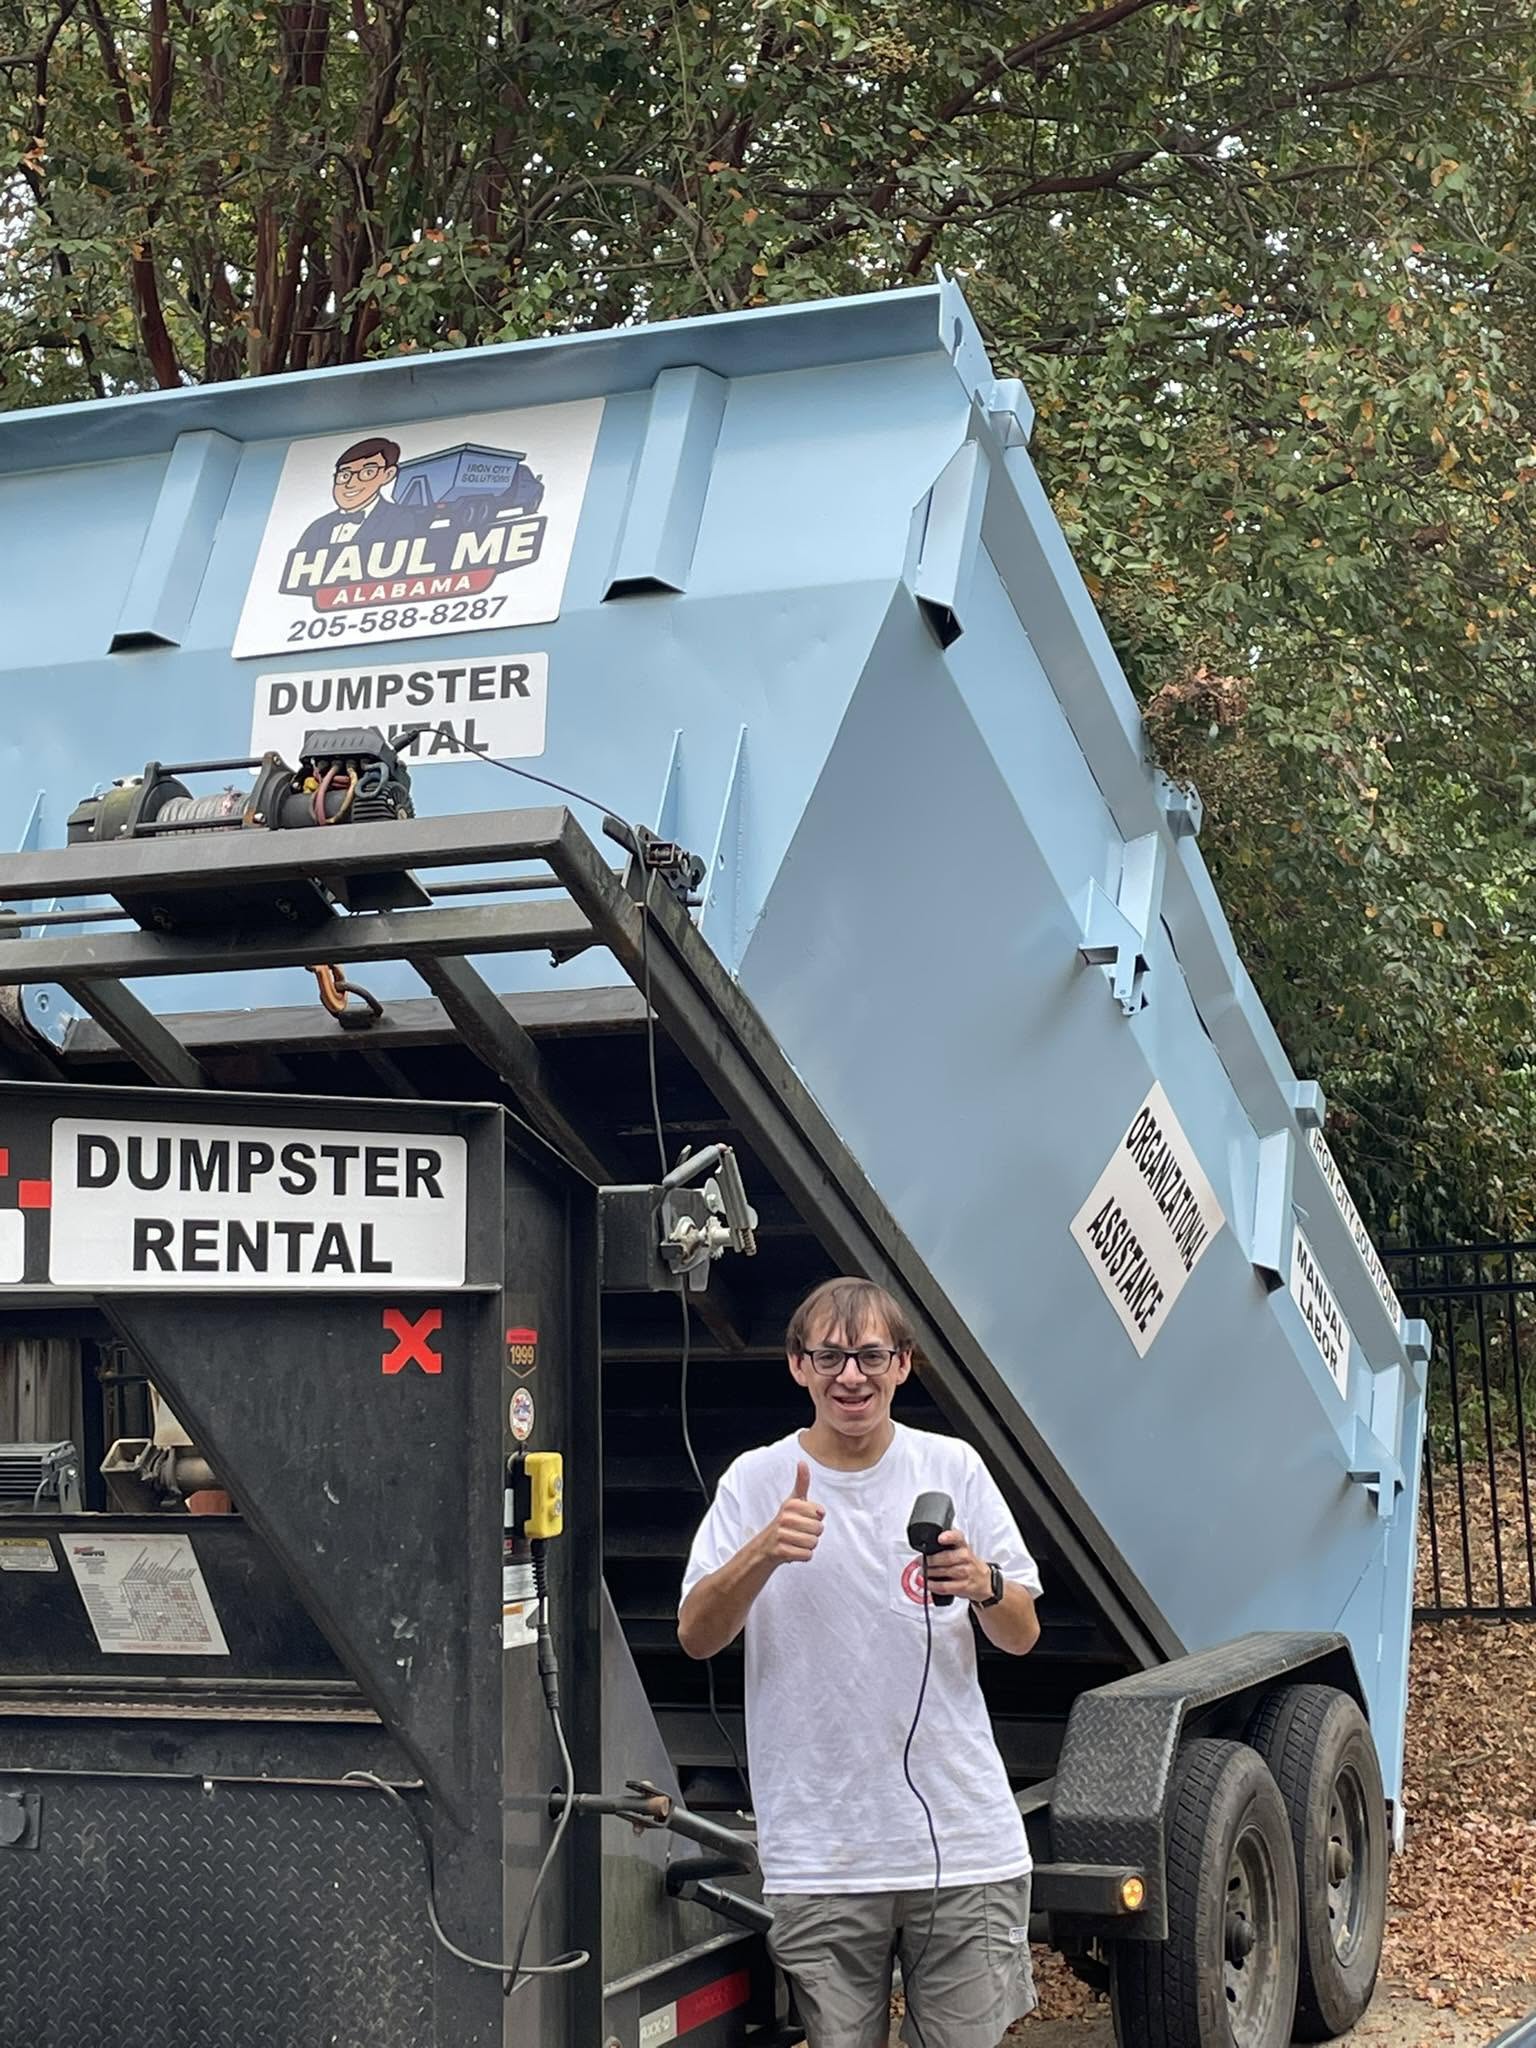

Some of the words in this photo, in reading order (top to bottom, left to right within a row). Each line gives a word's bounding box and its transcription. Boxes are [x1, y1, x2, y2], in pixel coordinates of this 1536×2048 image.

[286, 537, 438, 589] HAUL
[450, 521, 540, 571] ME
[286, 596, 508, 643] 205-588-8287
[331, 574, 472, 606] ALABAMA
[268, 662, 531, 717] DUMPSTER
[305, 718, 489, 757] NTAL
[76, 1133, 444, 1199] DUMPSTER
[1126, 1106, 1208, 1272] ORGANIZATIONAL
[133, 1217, 393, 1274] RENTAL
[1086, 1196, 1165, 1333] ASSISTANCE
[1297, 1239, 1344, 1351] MANUAL
[510, 1345, 535, 1365] 1999
[1299, 1285, 1338, 1377] LABOR
